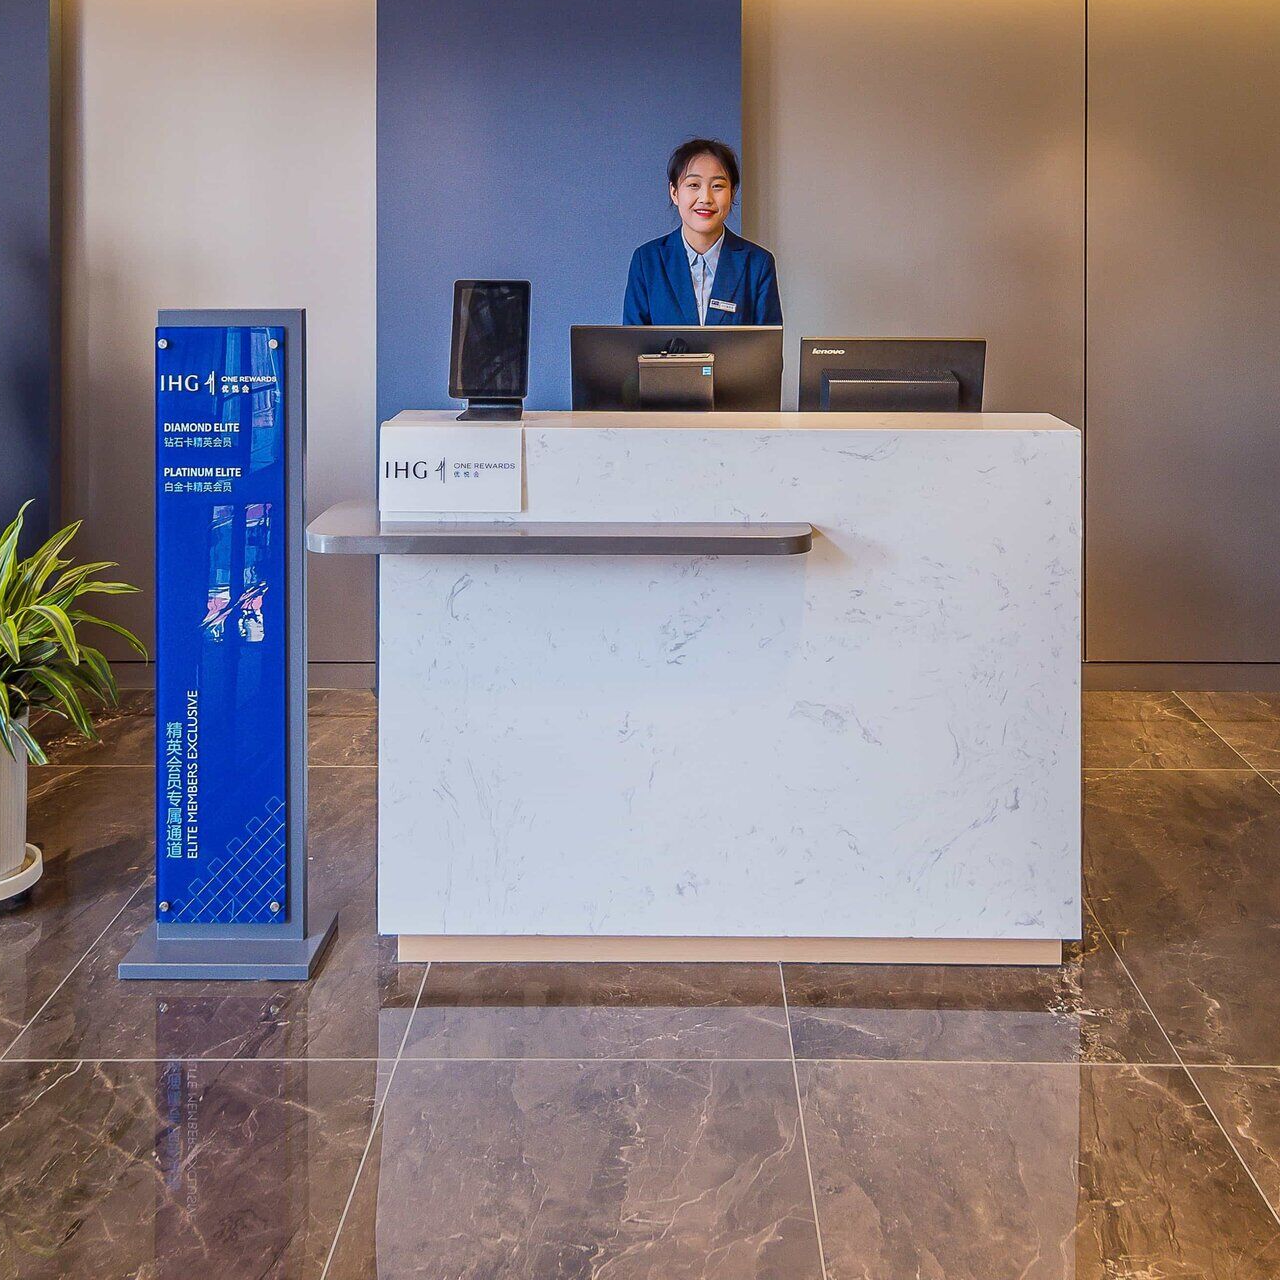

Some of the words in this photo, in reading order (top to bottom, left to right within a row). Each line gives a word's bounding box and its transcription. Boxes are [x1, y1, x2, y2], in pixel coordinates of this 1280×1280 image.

[160, 374, 199, 392] IHG
[221, 375, 238, 383] ONE
[239, 375, 277, 383] REWARDS
[163, 422, 212, 433] DIAMOND
[213, 422, 240, 433] ELITE
[163, 436, 232, 448] 钻石卡精英会员
[163, 467, 214, 477] PLATINUM
[215, 467, 242, 477] ELITE
[384, 460, 428, 480] IHG
[453, 462, 472, 470] ONE
[473, 462, 516, 470] REWARDS
[163, 481, 232, 493] 白金卡精英会员
[187, 689, 198, 760] EXCLUSIVE
[166, 721, 183, 859] 精英会员专属通道
[187, 762, 198, 823] MEMBERS
[187, 826, 198, 859] ELITE
